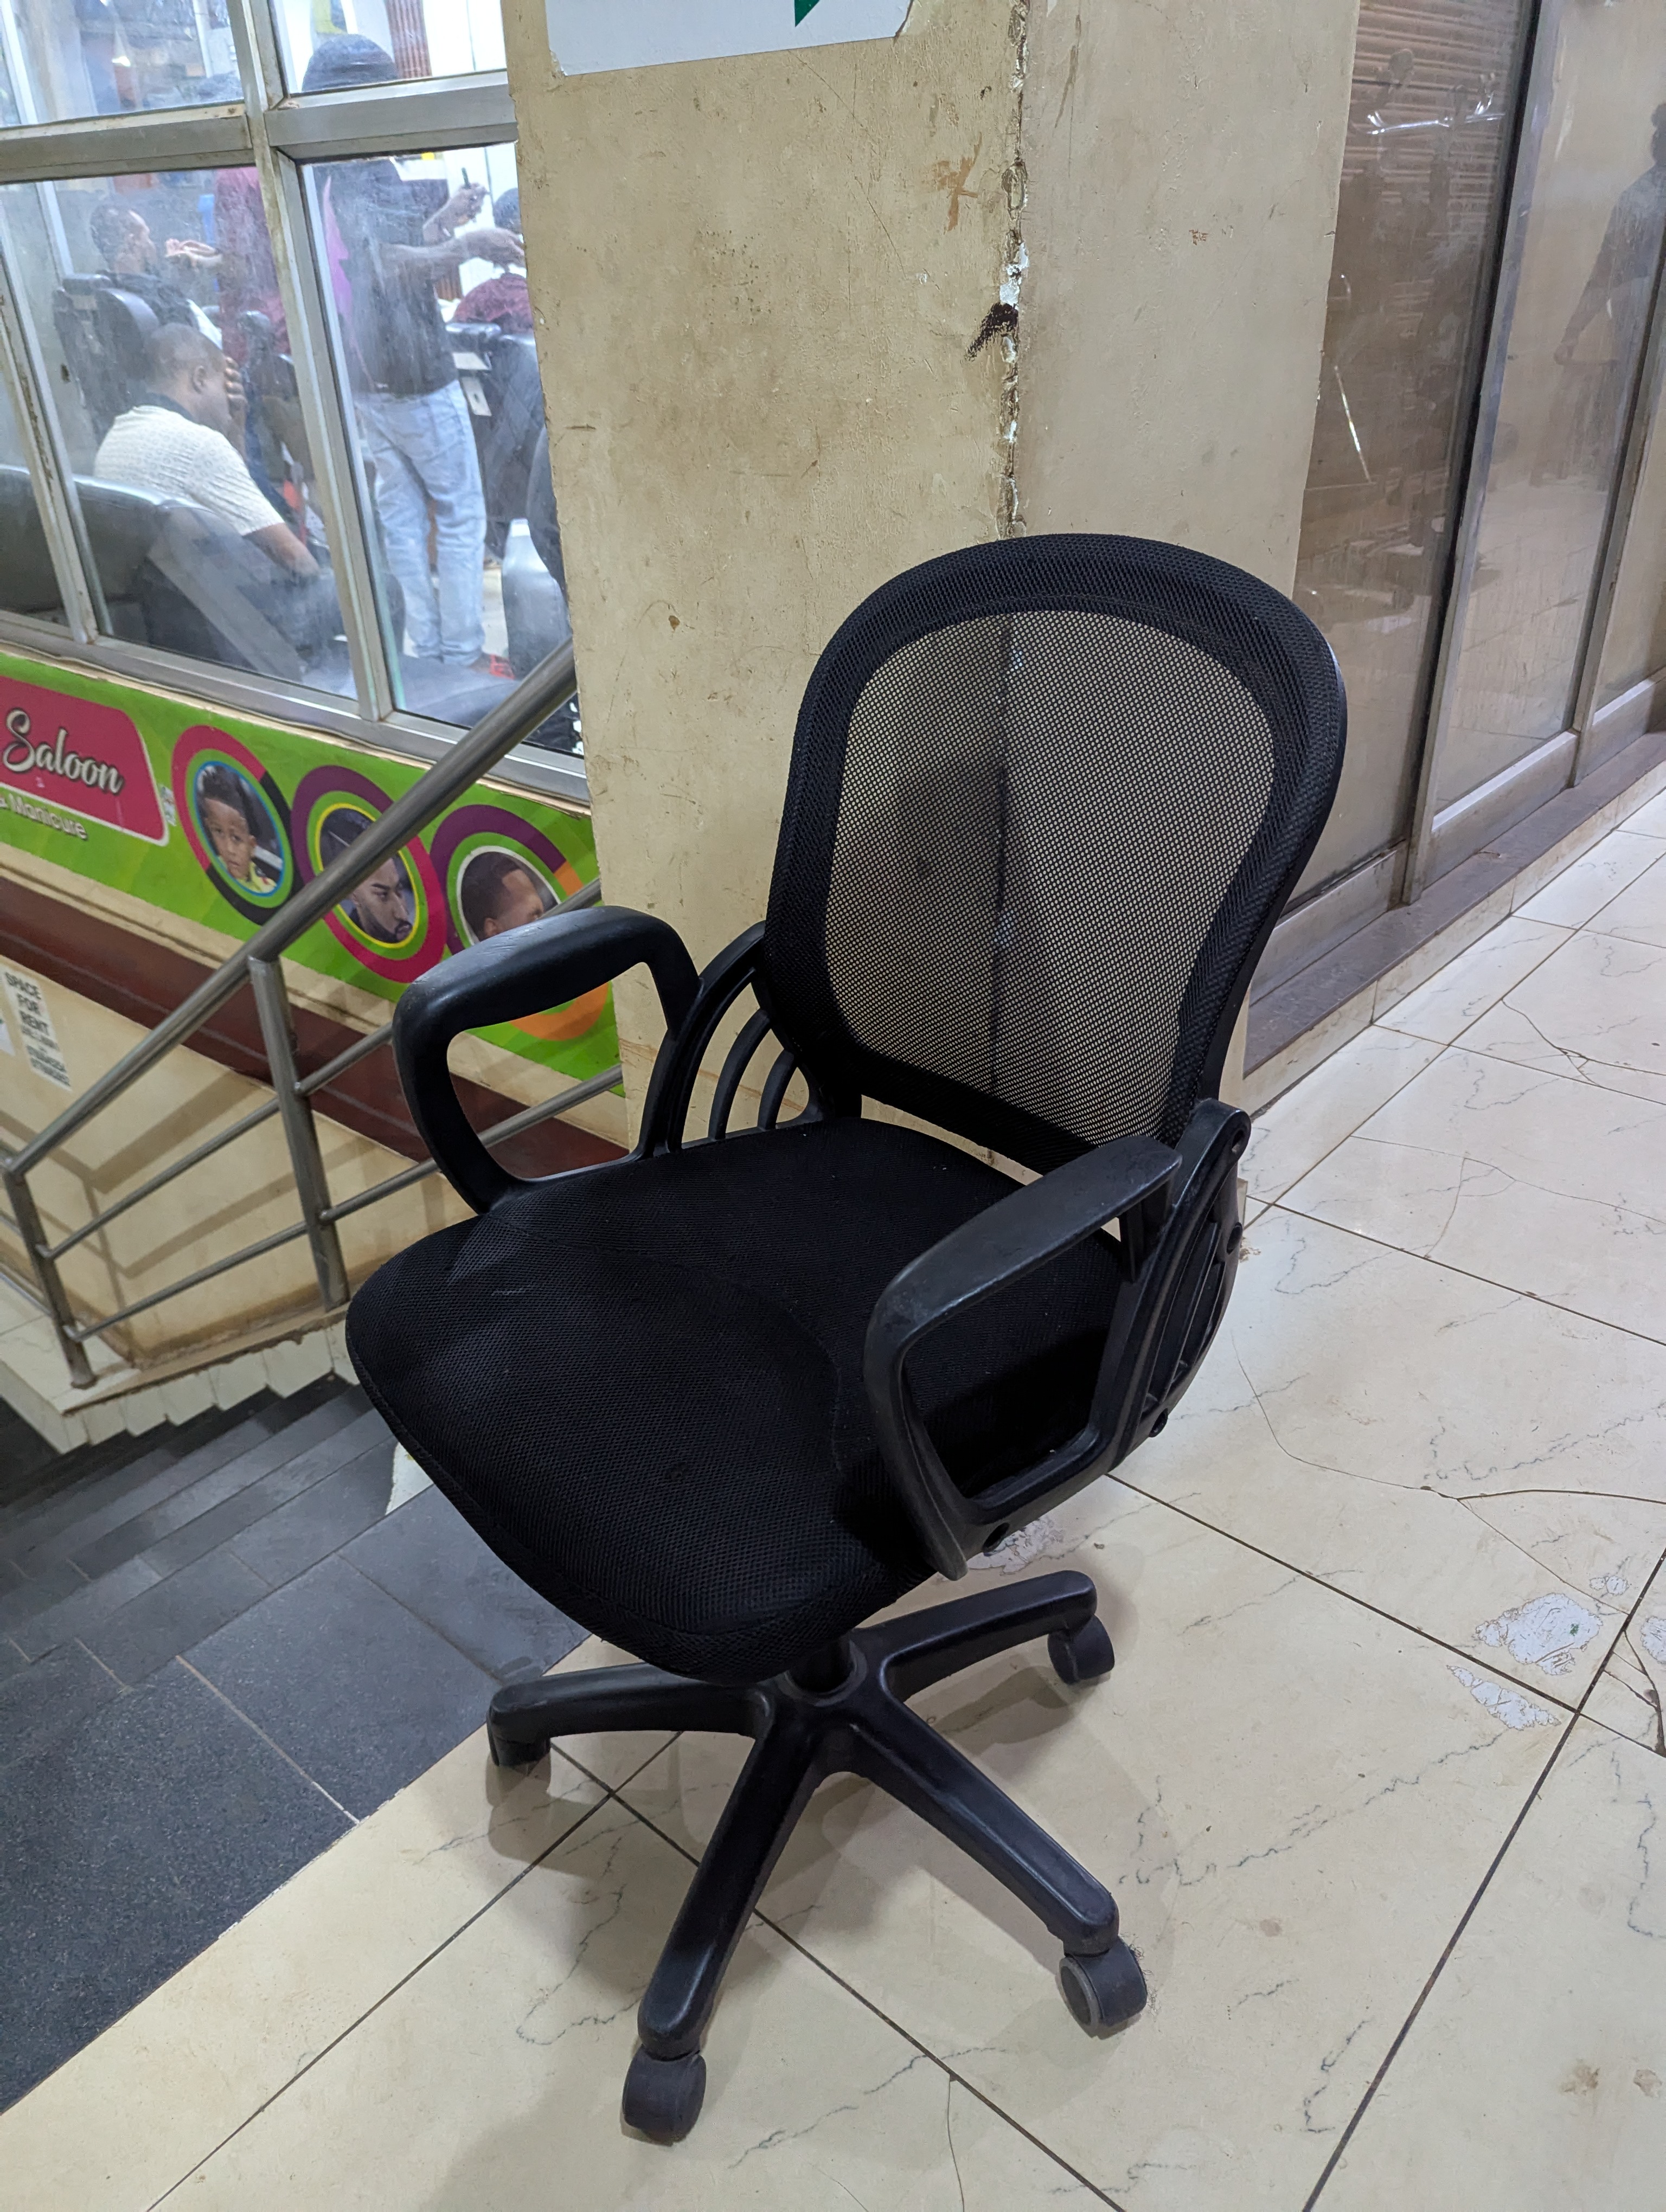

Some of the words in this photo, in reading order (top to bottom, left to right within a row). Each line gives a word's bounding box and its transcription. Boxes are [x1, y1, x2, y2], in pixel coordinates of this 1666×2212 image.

[3, 708, 124, 795] Saloon
[8, 793, 88, 840] Manicure
[5, 971, 42, 1000] SPACE
